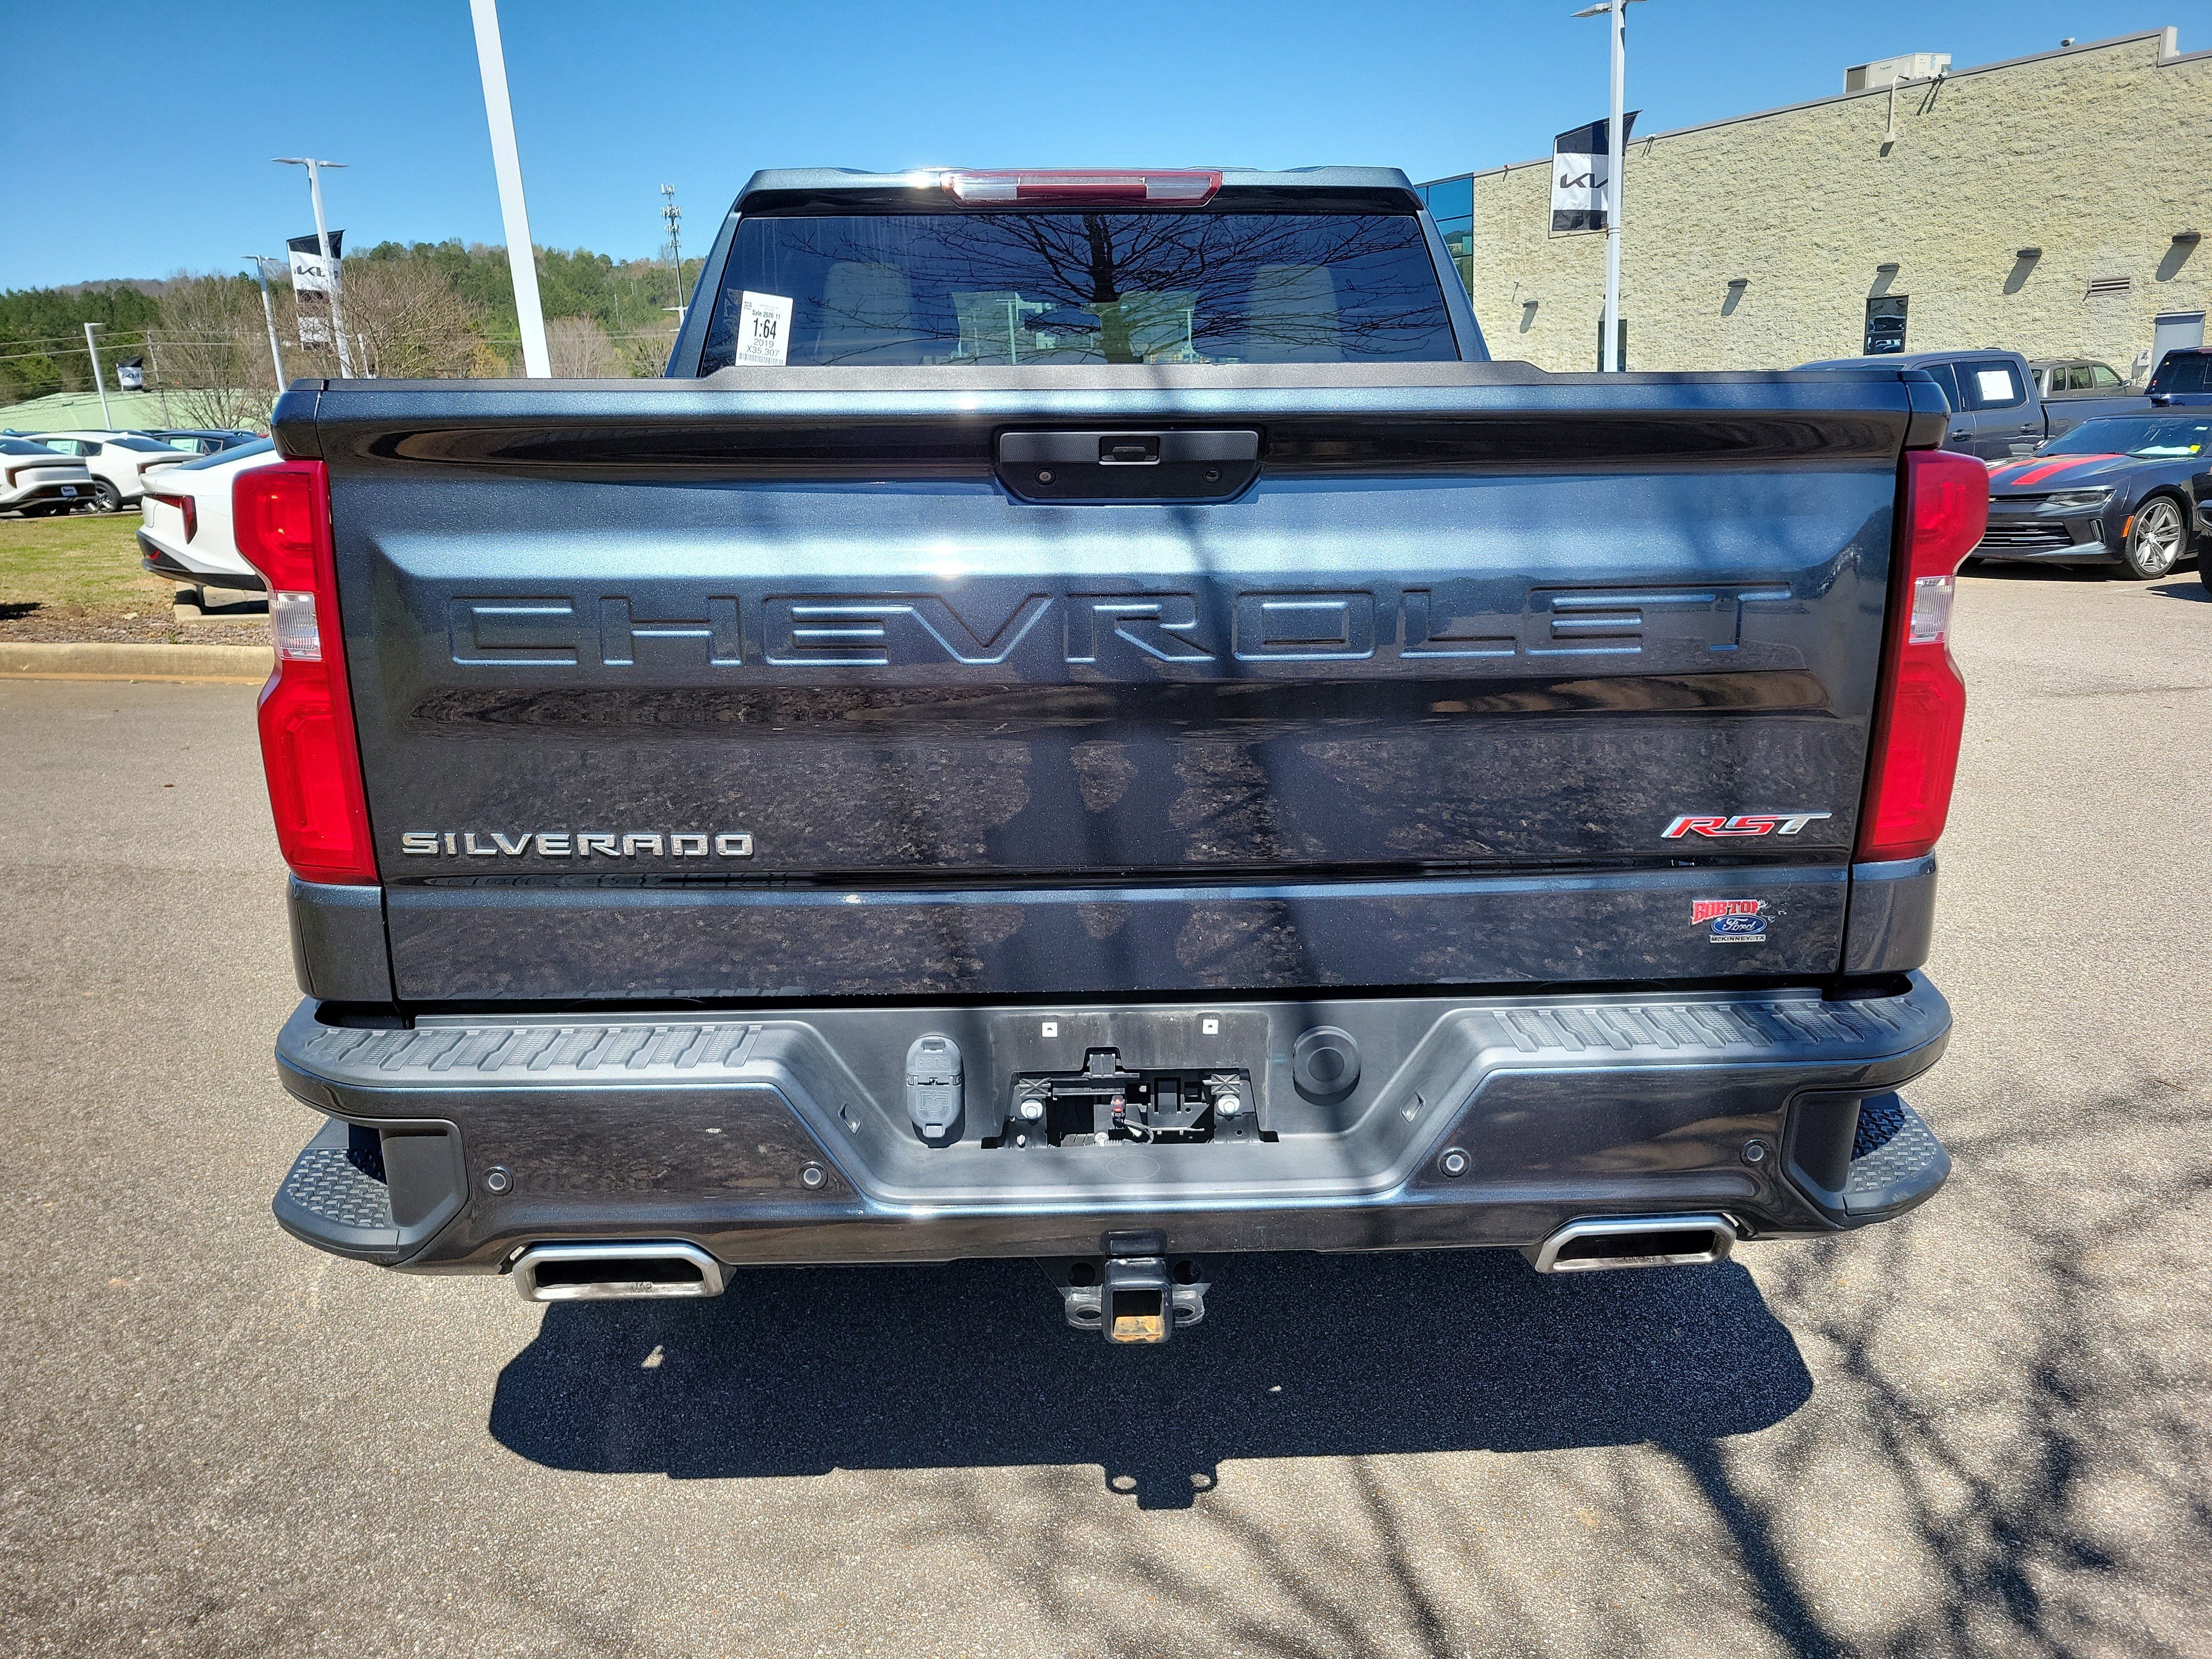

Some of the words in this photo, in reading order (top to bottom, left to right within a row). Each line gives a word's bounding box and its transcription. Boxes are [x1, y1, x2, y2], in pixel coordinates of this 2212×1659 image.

[753, 318, 777, 340] 1:64
[746, 345, 780, 357] X35,307
[754, 338, 774, 348] 2019
[449, 583, 1792, 665] CHEVROLET
[1661, 813, 1832, 838] RST
[402, 831, 754, 857] SILVERADO
[1692, 901, 1727, 922] BOB
[1722, 918, 1756, 931] Ford
